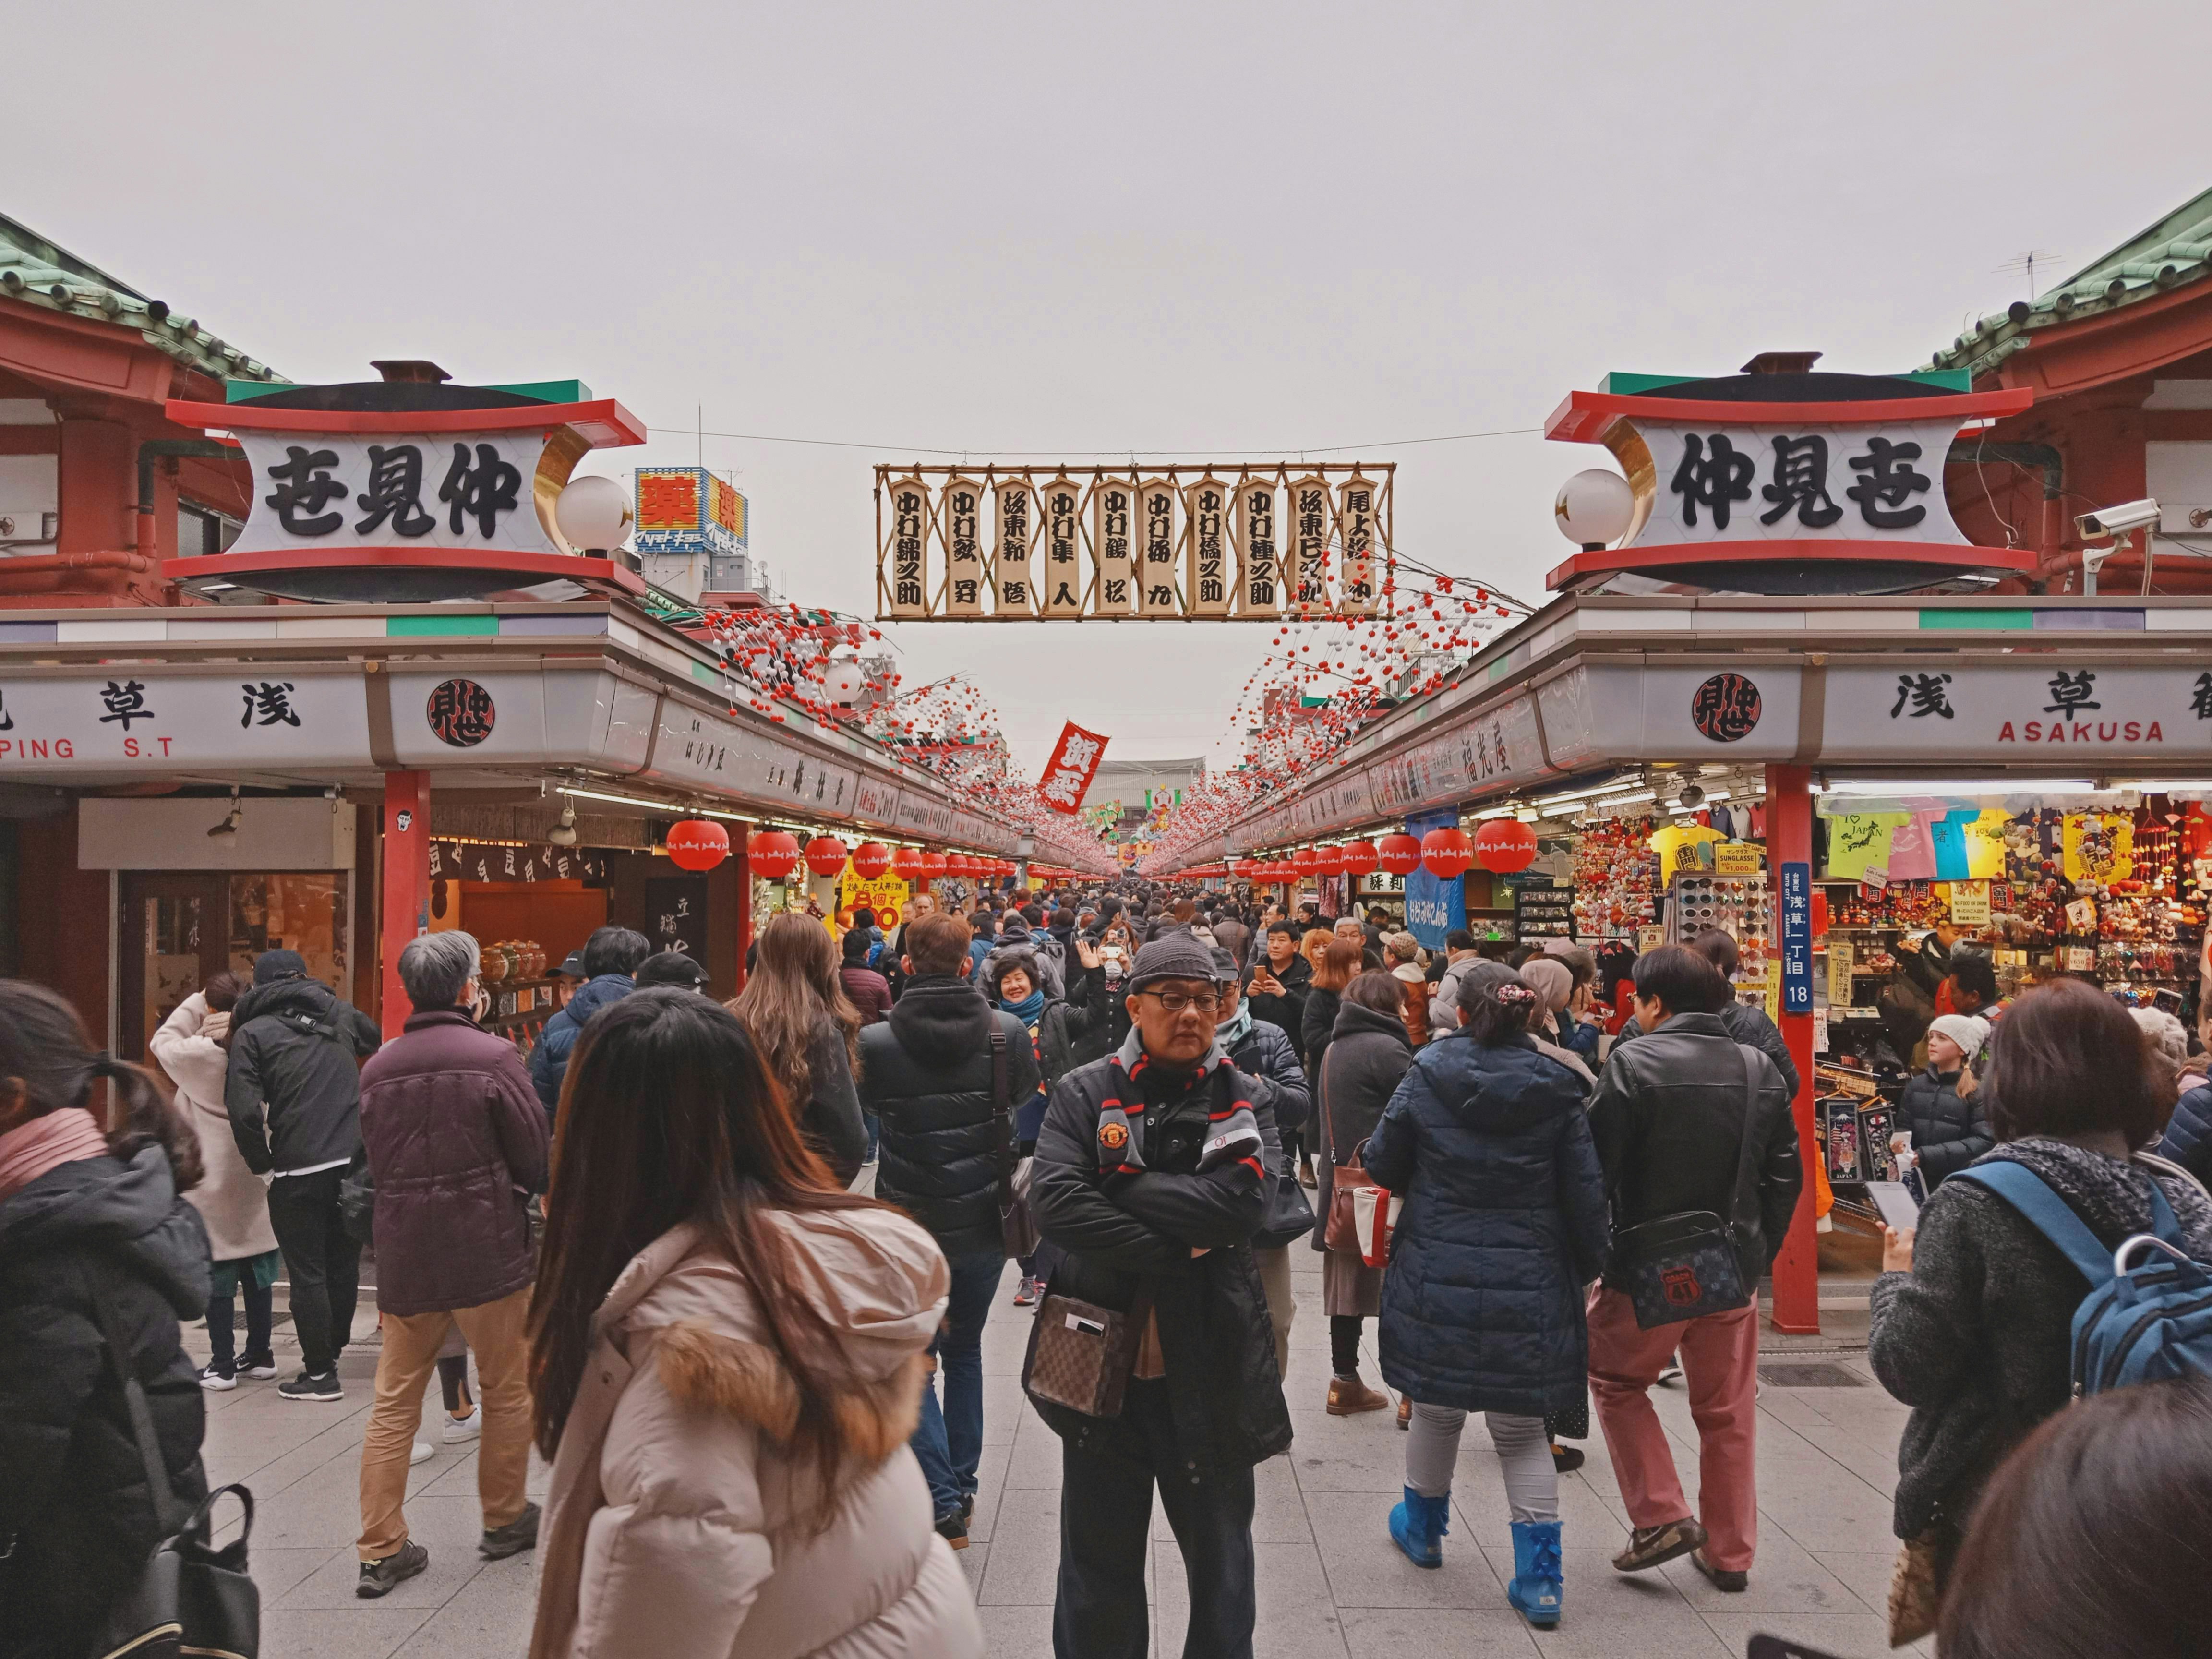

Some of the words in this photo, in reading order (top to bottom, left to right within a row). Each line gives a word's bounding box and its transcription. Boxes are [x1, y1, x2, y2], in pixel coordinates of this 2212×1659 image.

[640, 476, 696, 526] 薬
[1051, 493, 1077, 606] 中村隼人
[1104, 491, 1127, 603] 中村鶴松
[1199, 490, 1222, 602] 中村橋之助
[1248, 491, 1274, 605] 中村種之助
[1999, 721, 2163, 742] ASAKUSA
[1751, 845, 1767, 854] SAMPLE
[1852, 826, 1883, 837] JAPAN
[1369, 874, 1403, 890] 評判
[1790, 896, 1803, 975] 浅草一丁目
[1790, 986, 1808, 1003] 18
